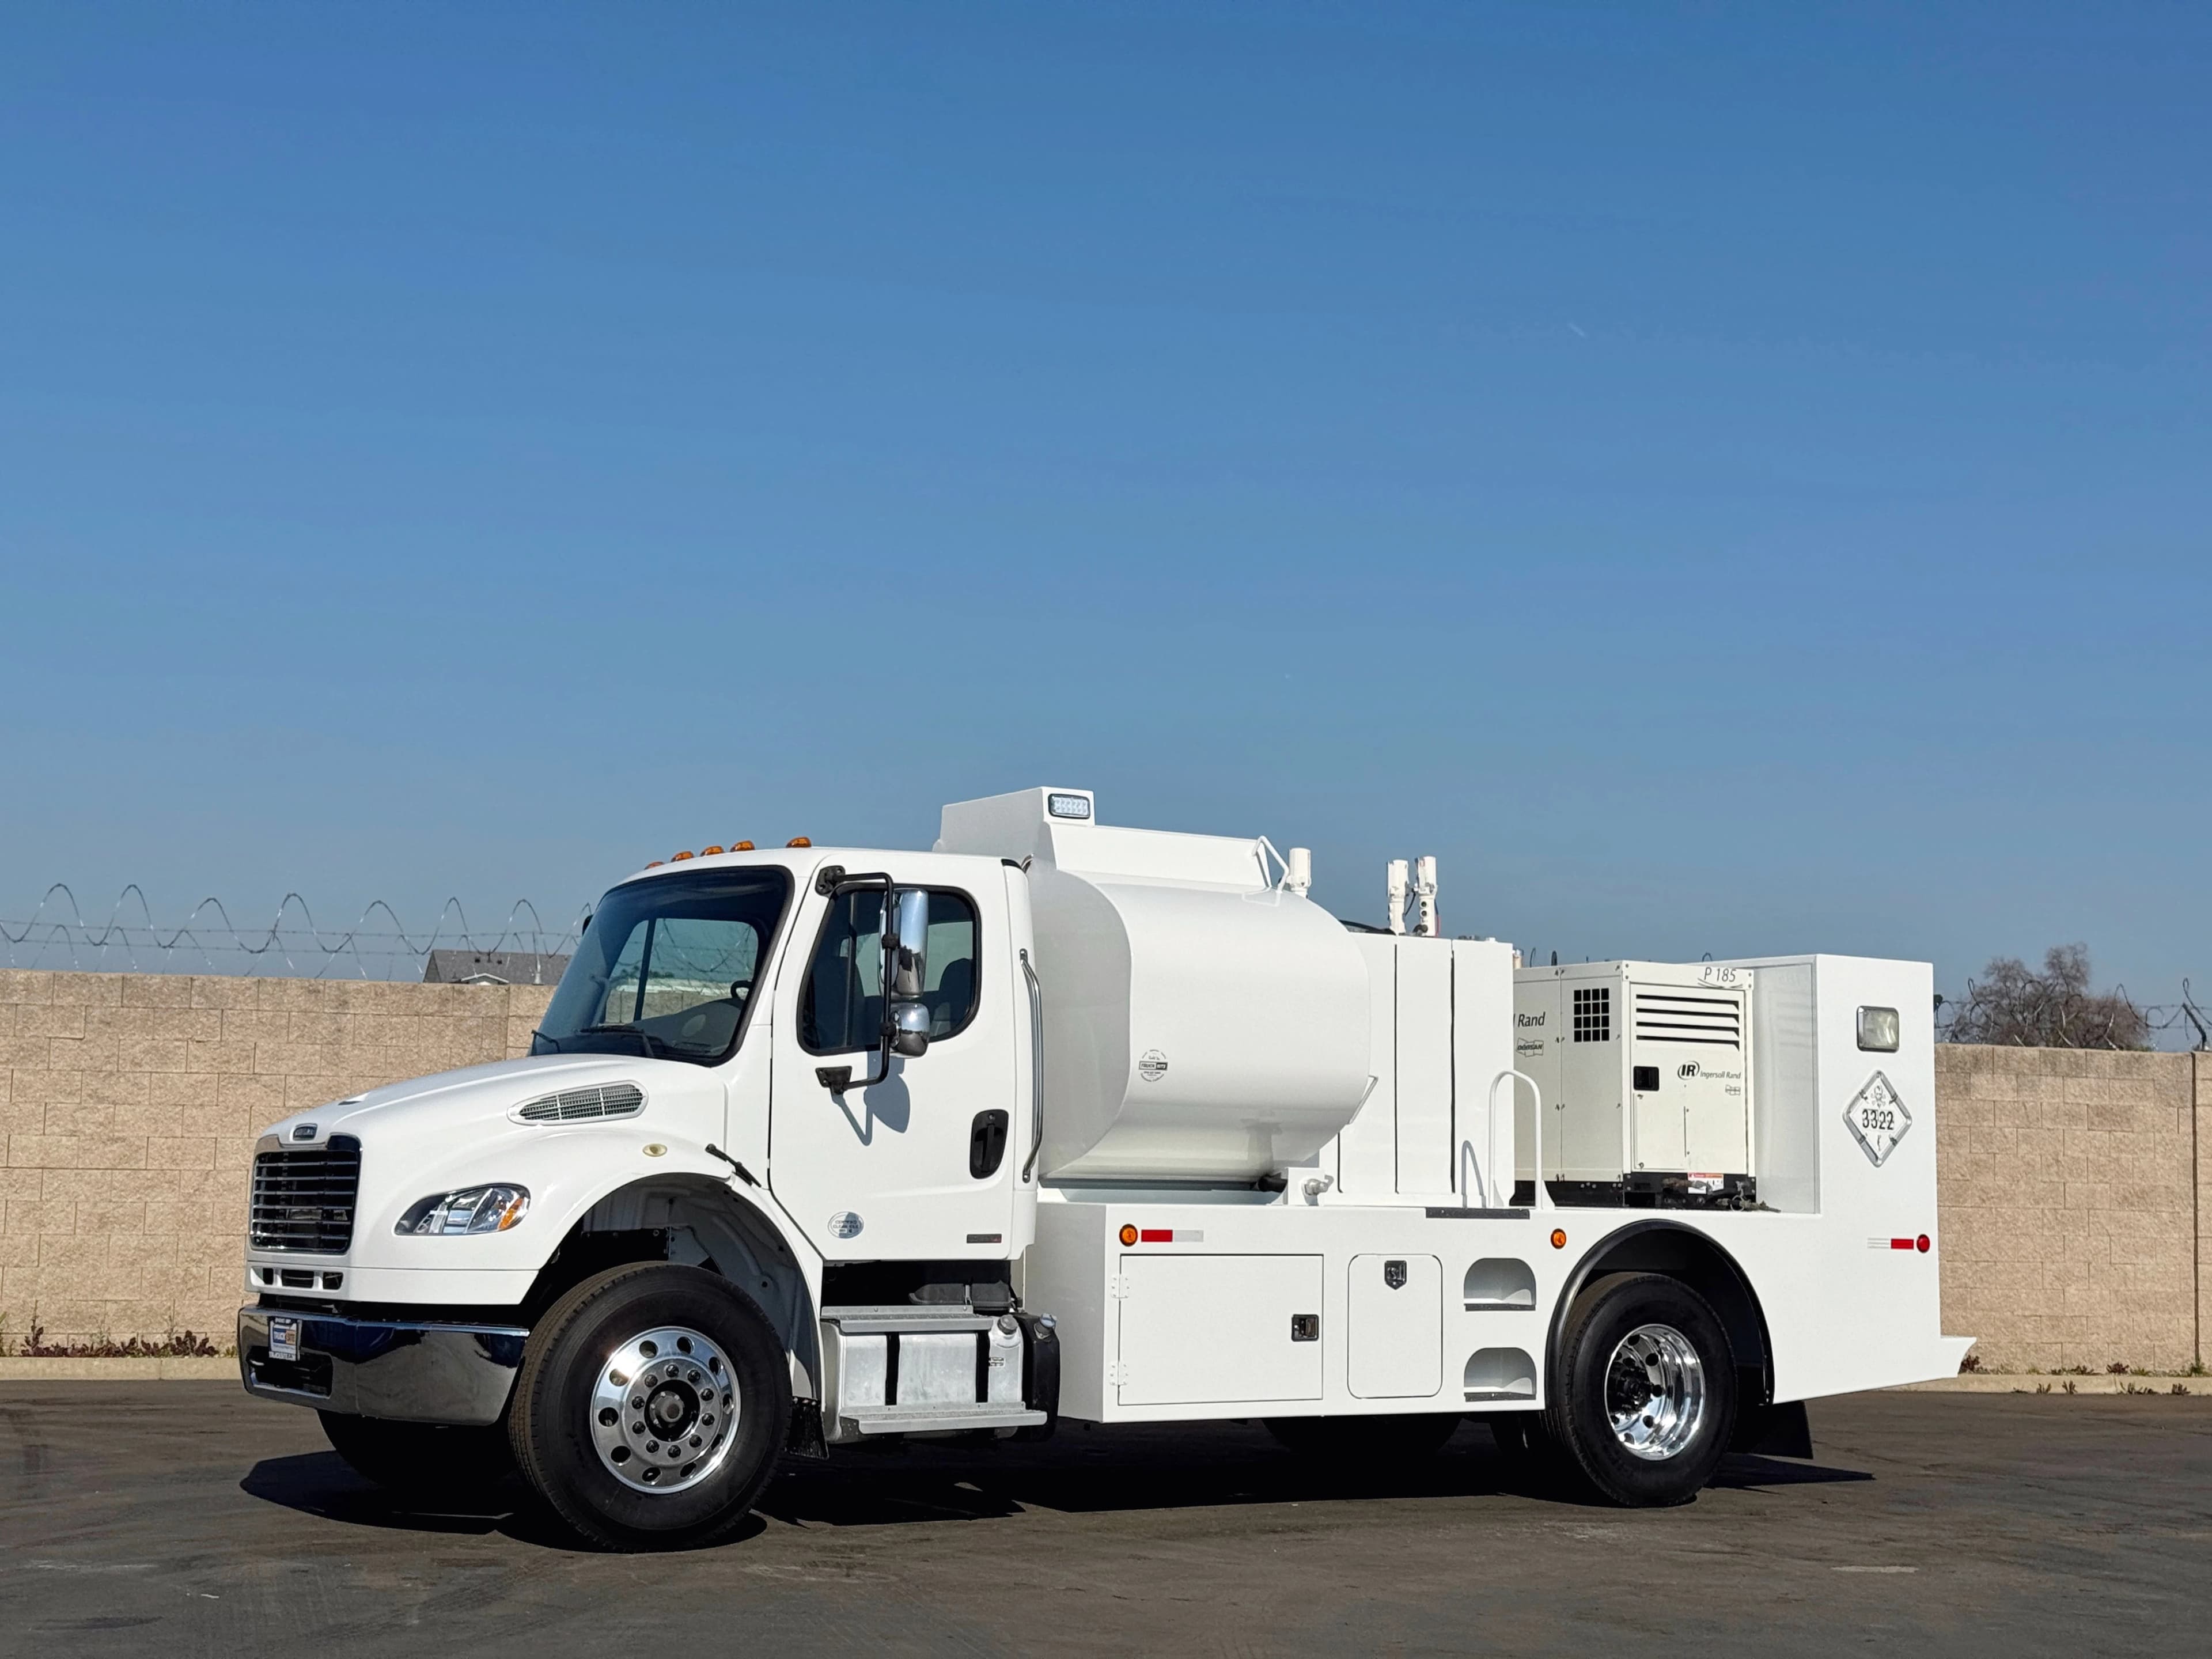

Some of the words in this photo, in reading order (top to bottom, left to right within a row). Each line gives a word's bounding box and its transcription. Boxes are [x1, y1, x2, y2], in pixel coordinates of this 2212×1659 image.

[1704, 967, 1713, 980] P
[1717, 968, 1736, 982] 185
[1517, 1011, 1546, 1028] Rand
[1681, 1064, 1696, 1077] IR
[1700, 1070, 1725, 1080] Ingersoll
[1726, 1071, 1741, 1079] Rand
[1862, 1108, 1894, 1130] 3322
